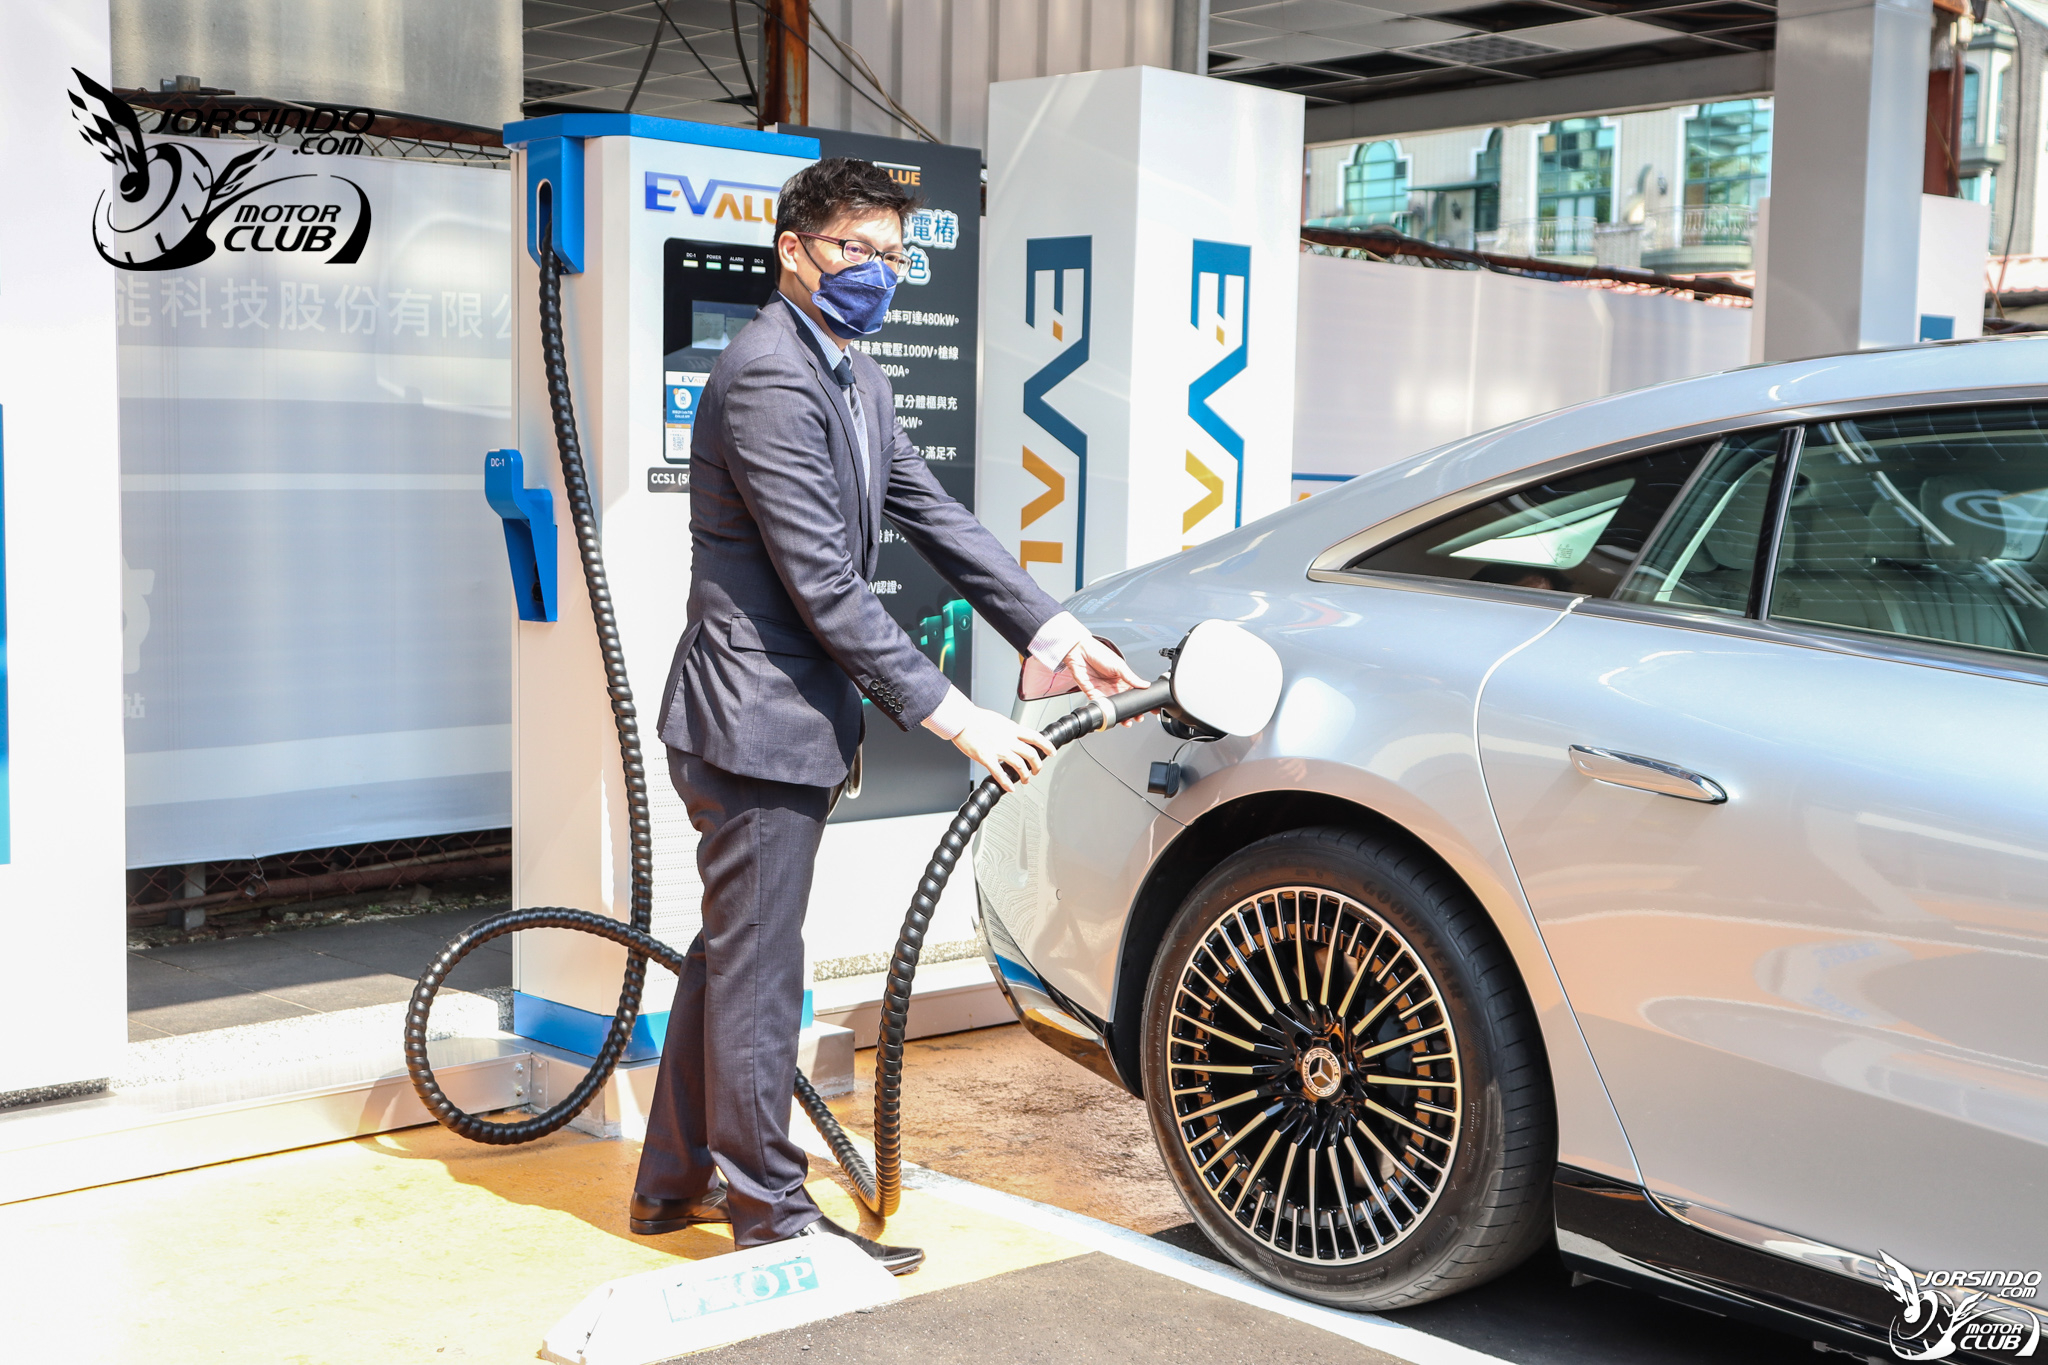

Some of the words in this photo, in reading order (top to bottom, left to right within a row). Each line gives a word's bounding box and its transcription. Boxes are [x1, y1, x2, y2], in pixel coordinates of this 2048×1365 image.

[903, 211, 958, 247] 電樁
[1182, 238, 1252, 552] EVA
[490, 457, 505, 467] DC-1
[651, 472, 676, 485] CCS1
